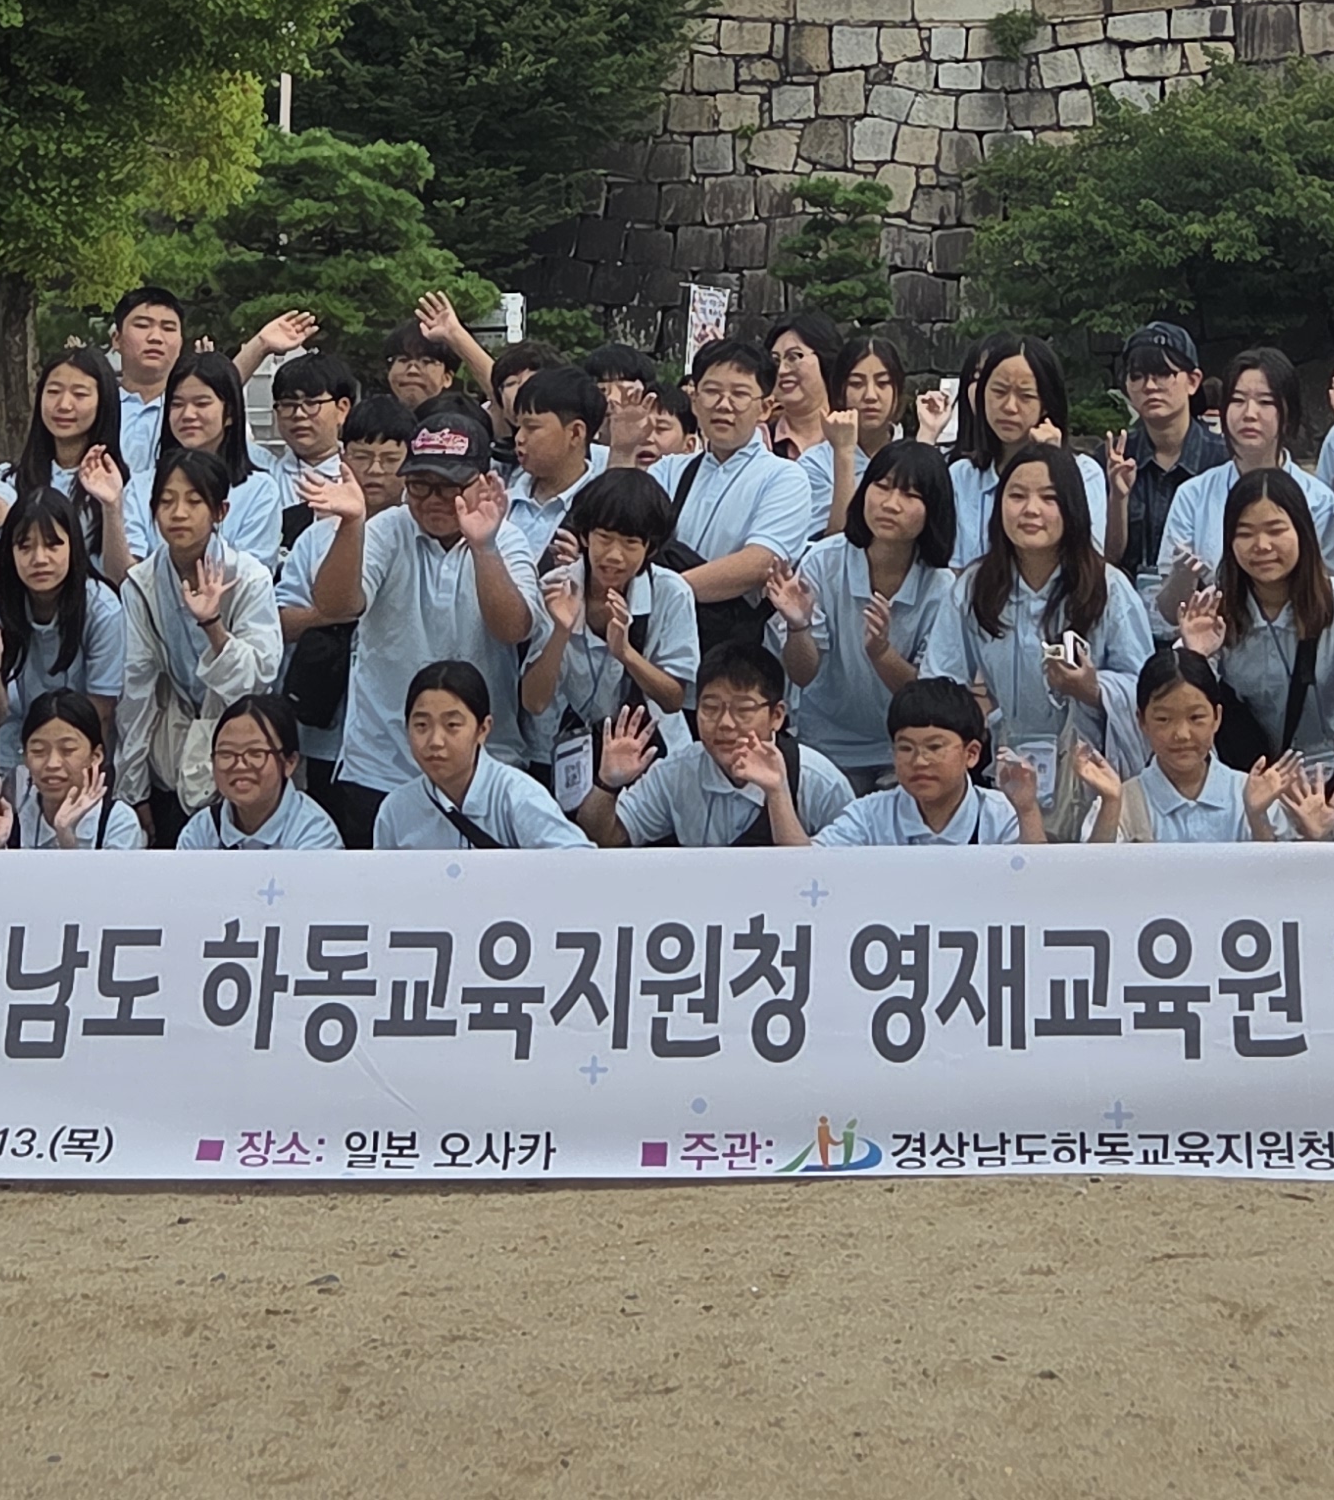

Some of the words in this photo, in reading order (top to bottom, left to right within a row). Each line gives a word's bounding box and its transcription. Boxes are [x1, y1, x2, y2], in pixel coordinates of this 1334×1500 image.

[203, 914, 811, 1063] 하동교육지원청
[850, 918, 1308, 1062] 영재교육원
[237, 1131, 325, 1166] 장소:
[345, 1131, 419, 1169] 일본
[434, 1131, 556, 1170] 오사카
[681, 1132, 773, 1170] 주관:
